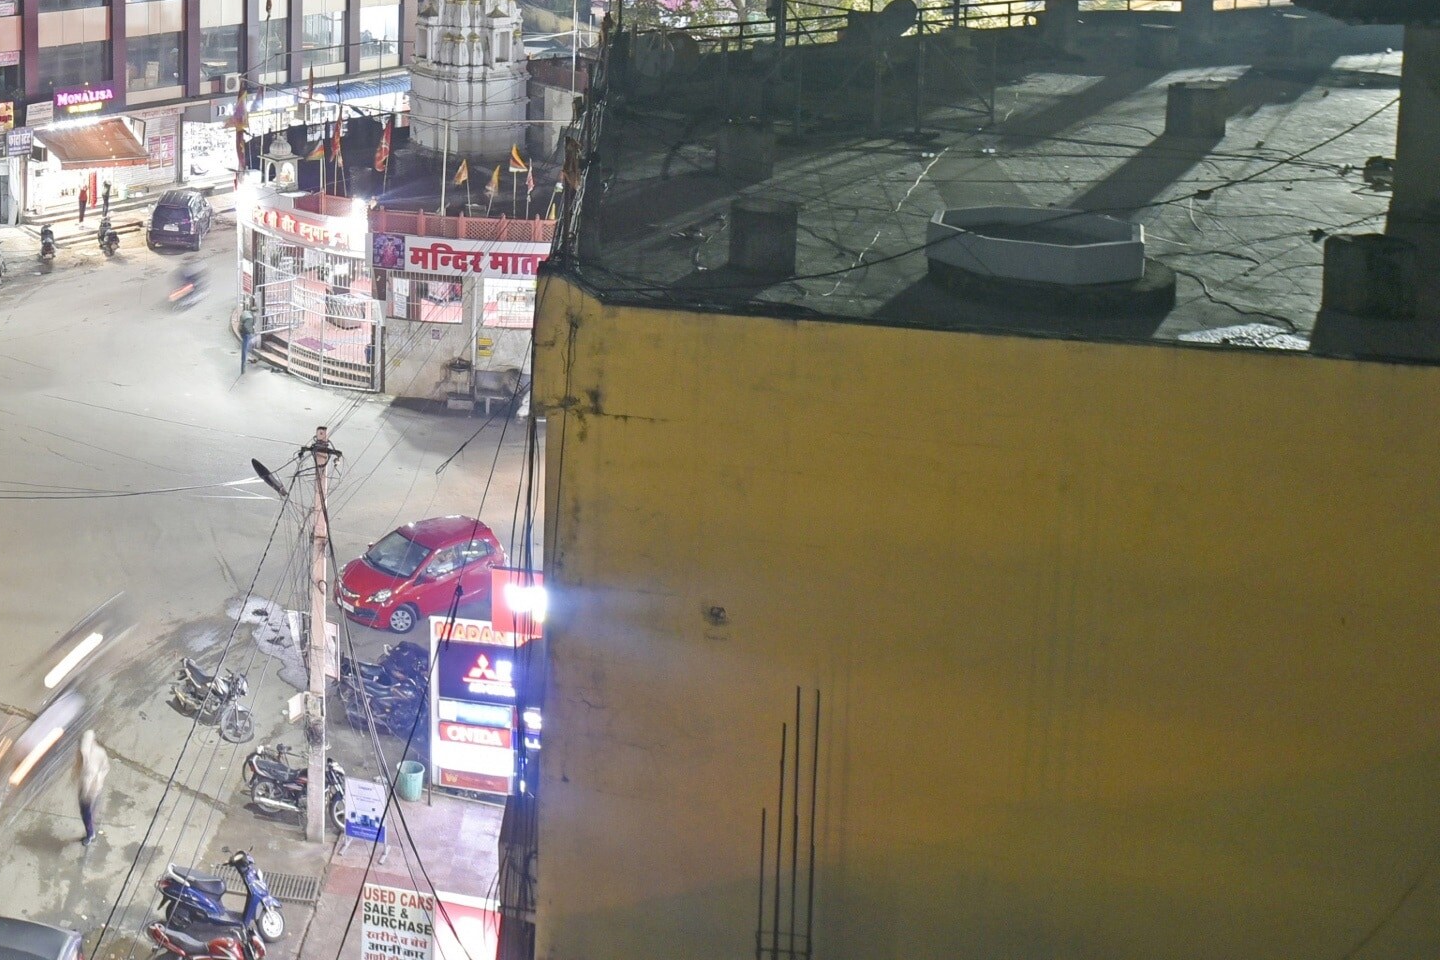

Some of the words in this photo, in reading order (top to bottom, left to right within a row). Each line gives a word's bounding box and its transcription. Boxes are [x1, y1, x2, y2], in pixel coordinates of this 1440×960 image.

[57, 89, 113, 106] MONALISA
[409, 242, 484, 273] मन्दिर
[488, 251, 550, 276] मात
[447, 725, 503, 746] ONIDA
[363, 887, 396, 904] USED
[400, 893, 434, 911] CARS
[364, 901, 396, 917] SALE
[400, 907, 409, 919] &
[363, 914, 433, 936] PURCHASE
[367, 941, 401, 955] अपनी
[403, 947, 425, 960] कार
